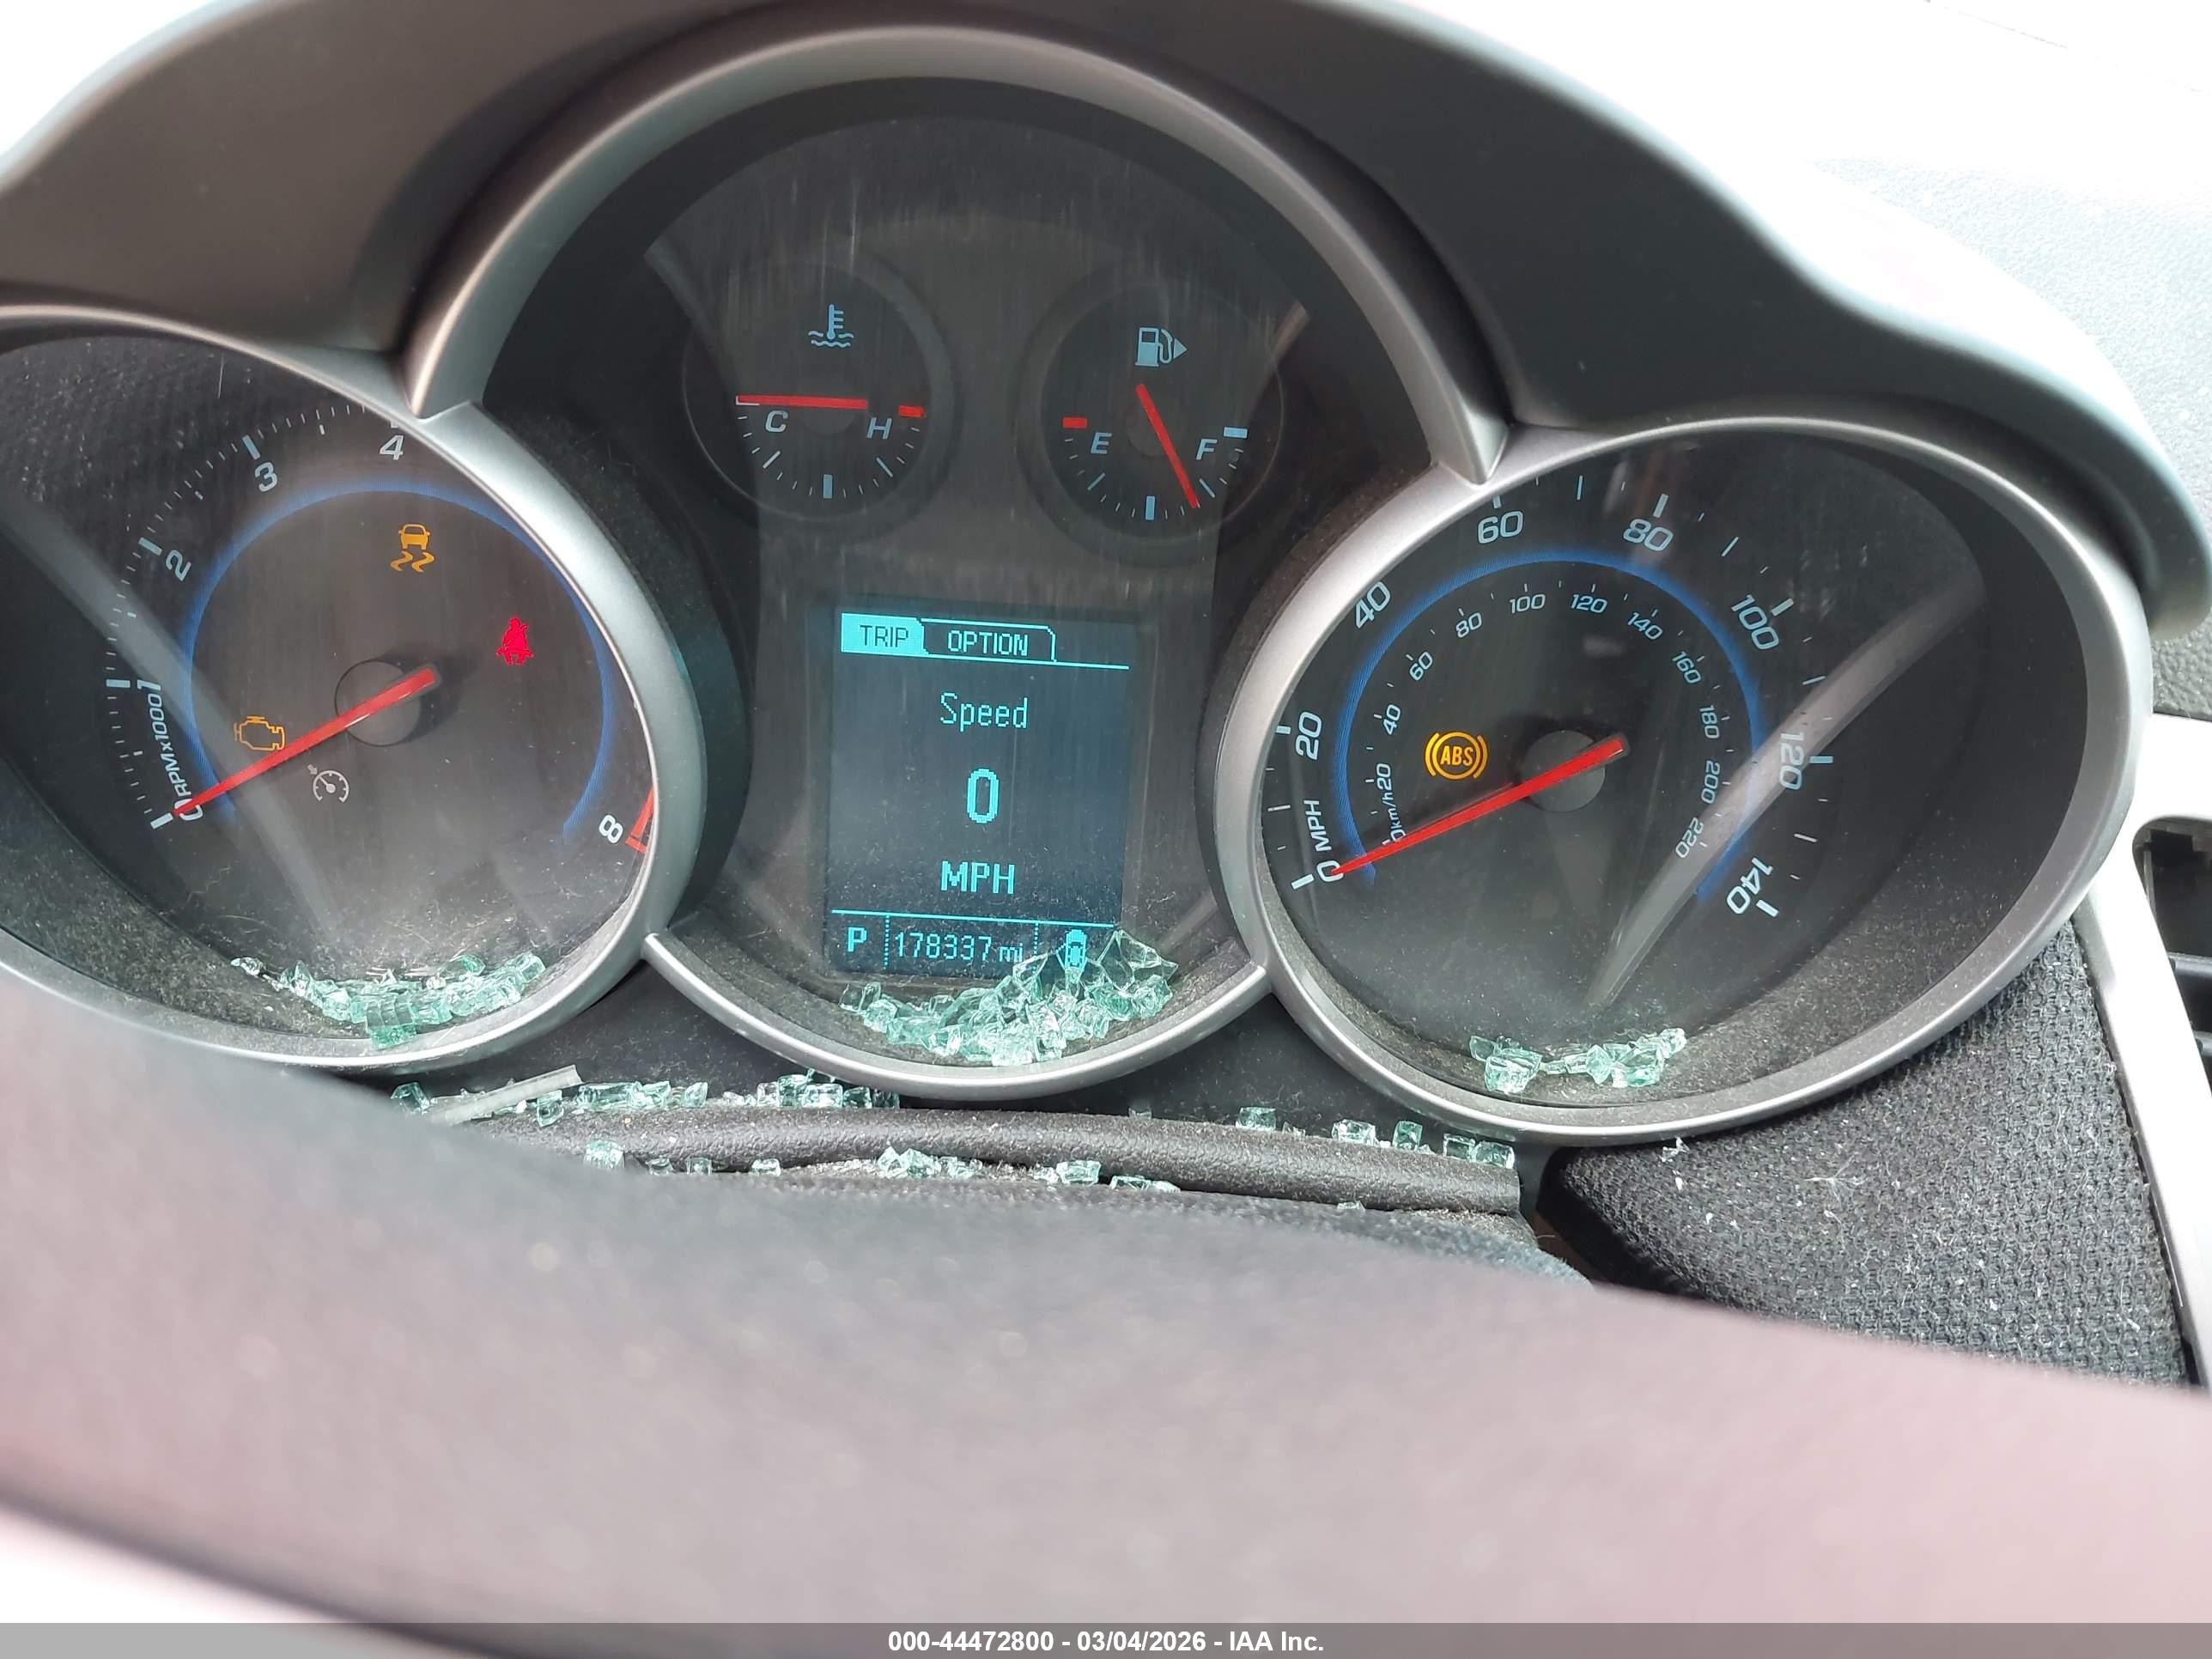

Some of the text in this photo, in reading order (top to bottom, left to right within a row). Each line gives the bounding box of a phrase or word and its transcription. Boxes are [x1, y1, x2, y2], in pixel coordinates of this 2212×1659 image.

[765, 411, 788, 432] C
[866, 417, 893, 440] H
[380, 435, 404, 460] 4
[1091, 432, 1113, 453] E
[1195, 439, 1218, 459] F
[255, 462, 277, 493] 3
[1478, 510, 1524, 544] 60
[1623, 519, 1673, 551] 80
[165, 550, 191, 580] 2
[1355, 580, 1391, 628] 40
[1509, 594, 1546, 614] 100
[1571, 594, 1607, 613] 120
[860, 625, 909, 648] TRIP
[1455, 612, 1483, 638] 80
[1627, 612, 1663, 641] 140
[1731, 594, 1779, 650] 100
[948, 630, 1029, 656] OPTION
[1409, 651, 1433, 681] 60
[1672, 651, 1701, 684] 160
[137, 679, 161, 690] 1
[940, 692, 1028, 732] Speed
[1382, 703, 1401, 735] 40
[1699, 705, 1720, 738] 180
[1295, 711, 1322, 761] 20
[1440, 745, 1474, 767] ABS
[1779, 732, 1804, 790] 120
[1376, 763, 1392, 791] 20
[1701, 760, 1721, 804] 200
[174, 799, 203, 821] 0
[967, 768, 1000, 823] 0
[599, 814, 623, 843] 8
[1304, 799, 1344, 882] 0 MPH
[1675, 817, 1705, 859] 220
[940, 860, 1015, 895] MPH
[1726, 858, 1773, 915] 140
[848, 927, 1024, 963] P 178337 mi
